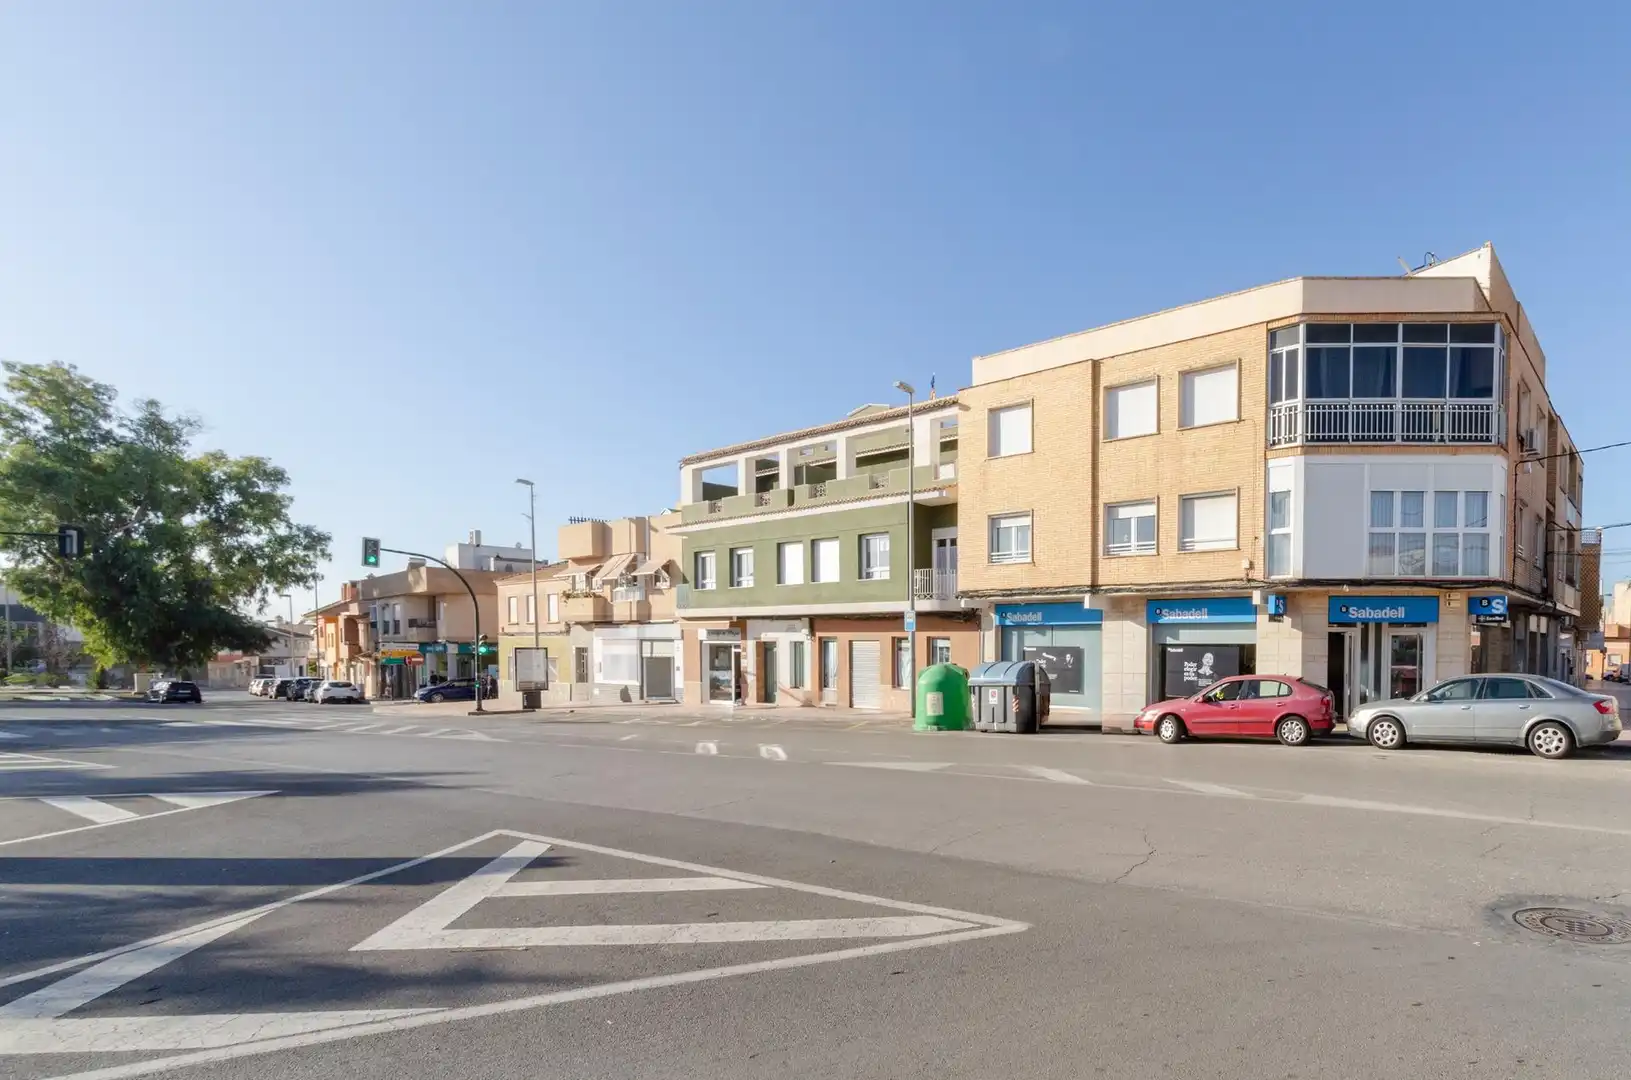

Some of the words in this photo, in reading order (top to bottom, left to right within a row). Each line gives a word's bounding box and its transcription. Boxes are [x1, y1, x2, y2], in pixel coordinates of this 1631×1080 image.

[1348, 606, 1405, 619] Sabadell
[1491, 598, 1505, 614] S
[1006, 611, 1042, 622] Sabadell
[1161, 607, 1208, 620] Sabadell
